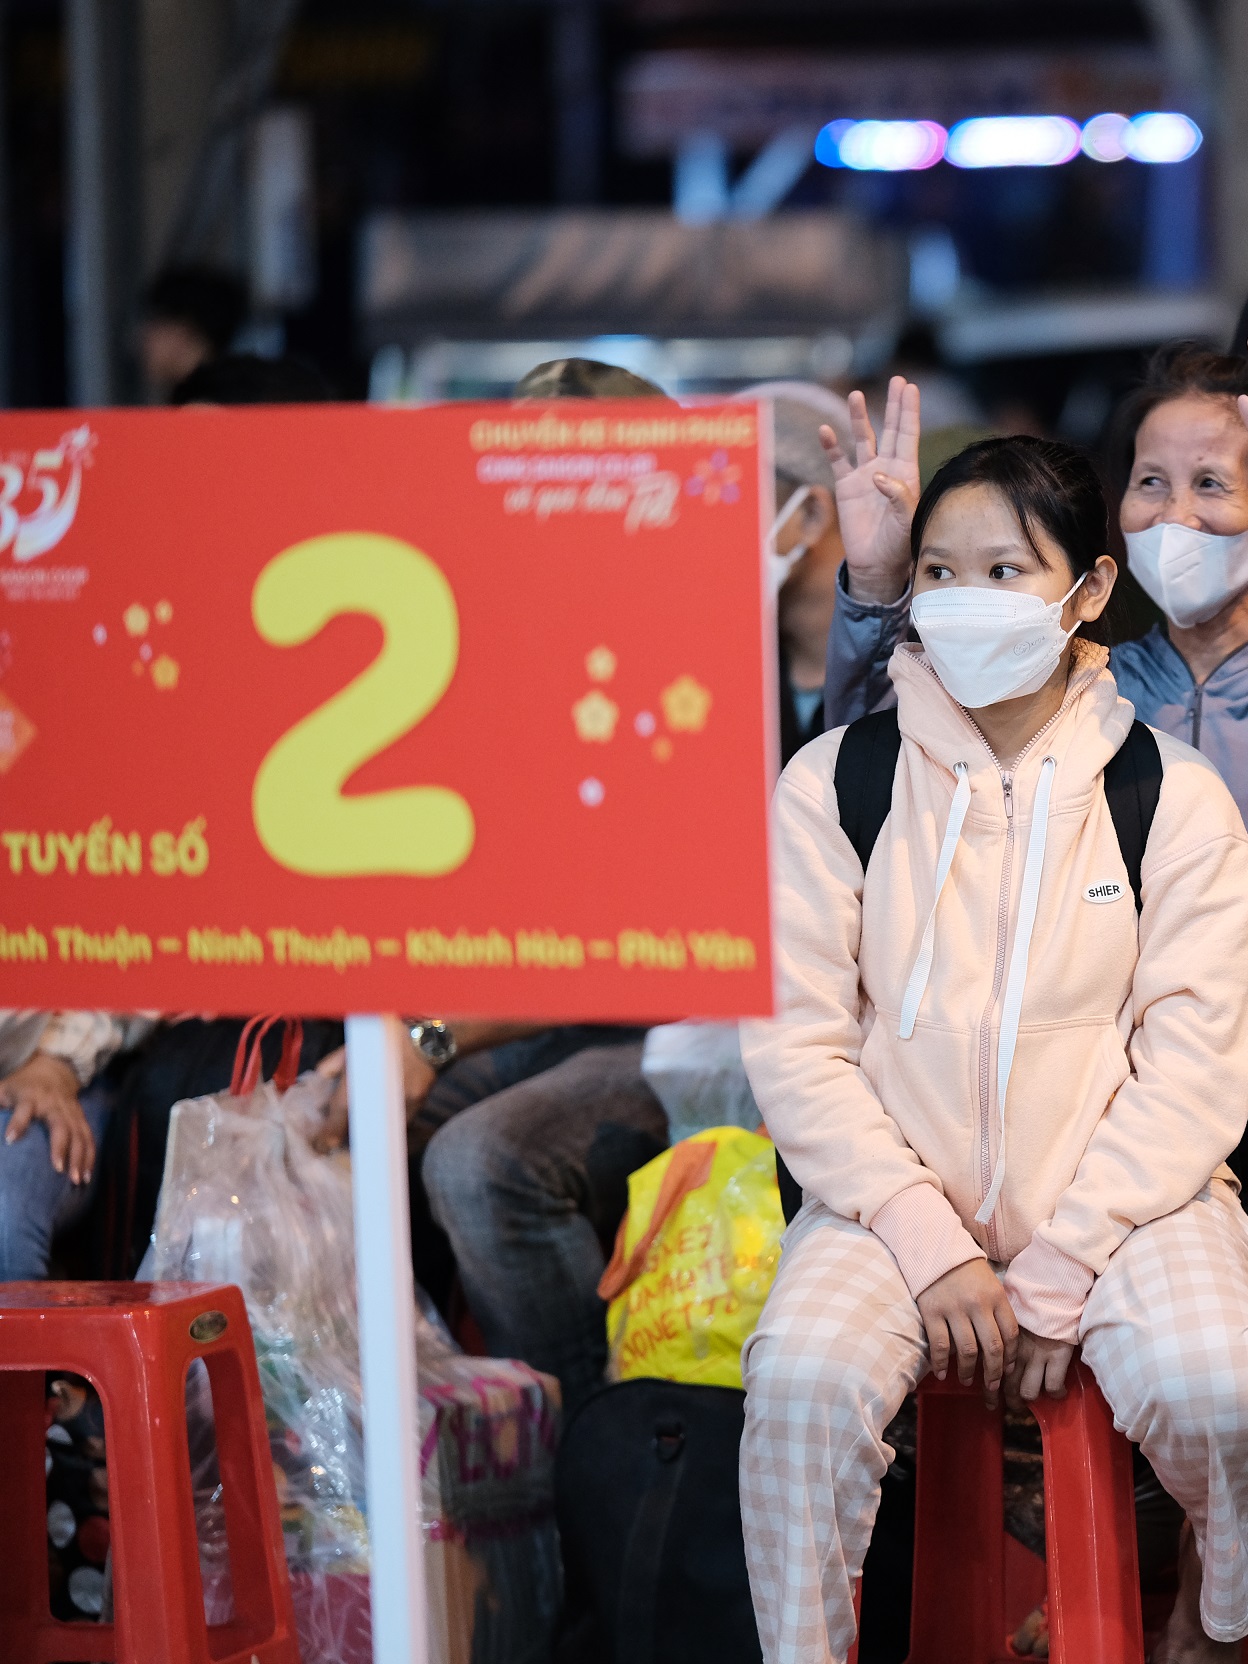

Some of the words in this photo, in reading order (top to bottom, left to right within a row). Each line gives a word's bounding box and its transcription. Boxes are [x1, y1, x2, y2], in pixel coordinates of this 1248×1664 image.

[252, 531, 475, 877] 2
[3, 814, 143, 876] TUYẾN
[150, 814, 209, 876] SỐ
[1088, 884, 1120, 898] SHIER
